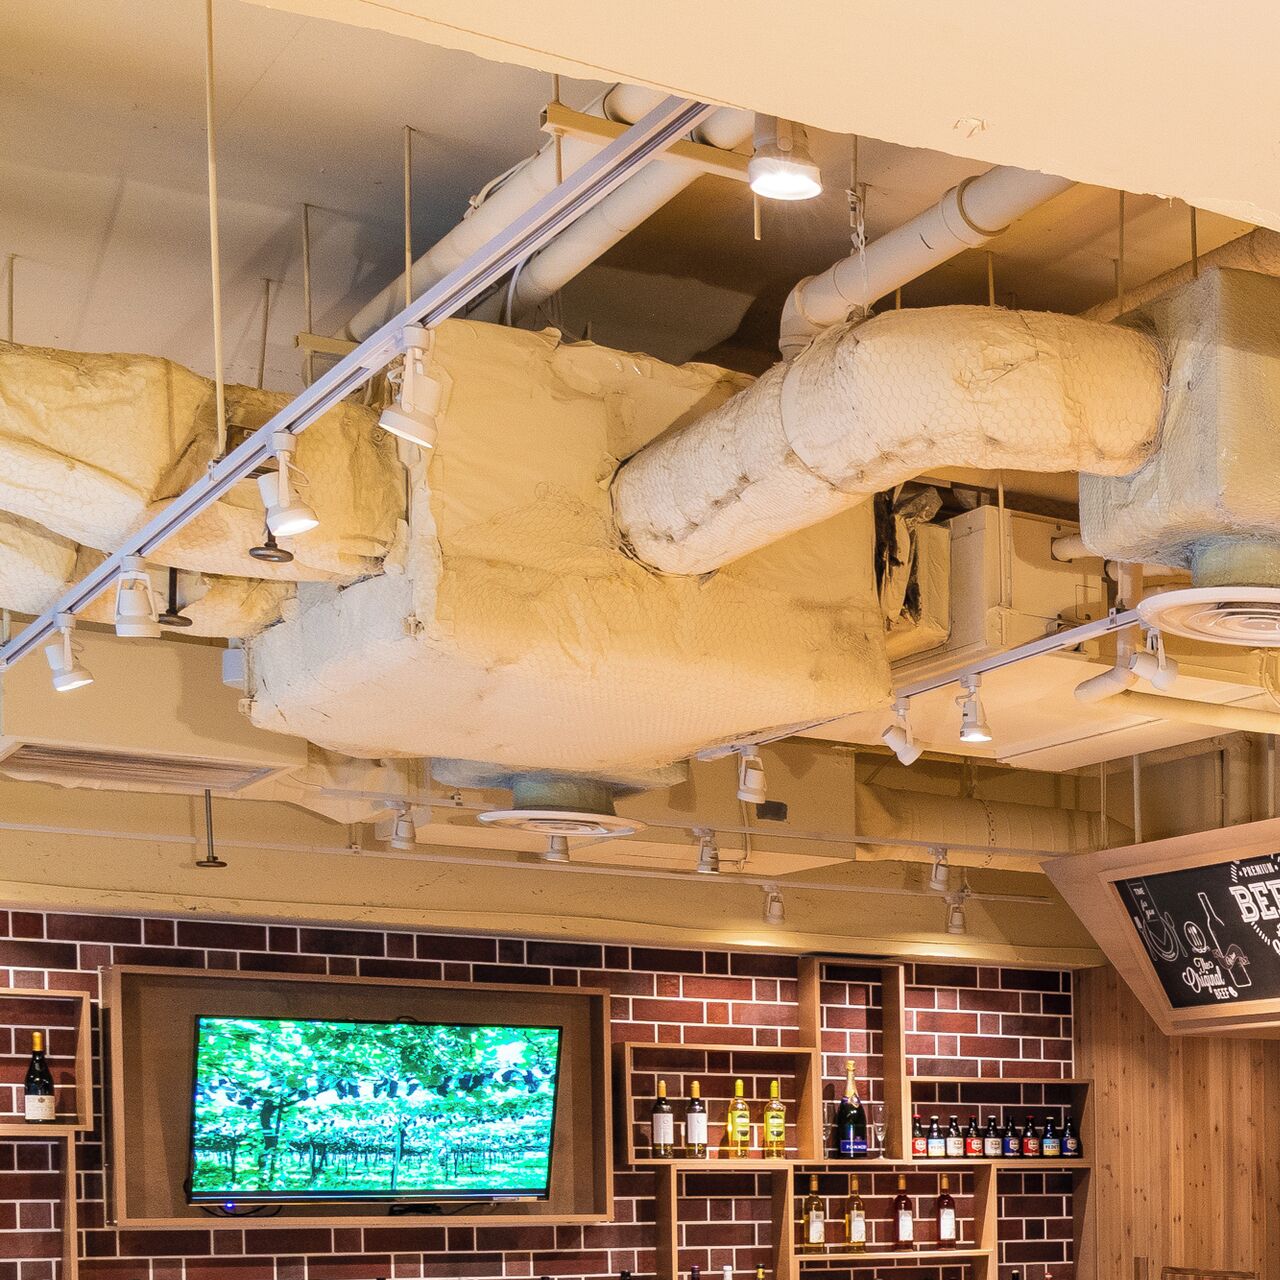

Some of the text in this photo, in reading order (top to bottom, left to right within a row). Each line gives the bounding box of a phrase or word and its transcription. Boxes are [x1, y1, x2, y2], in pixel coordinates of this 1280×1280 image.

[1242, 862, 1275, 878] PREMIUM
[1182, 965, 1226, 993] Original
[1213, 988, 1230, 1000] BEEF
